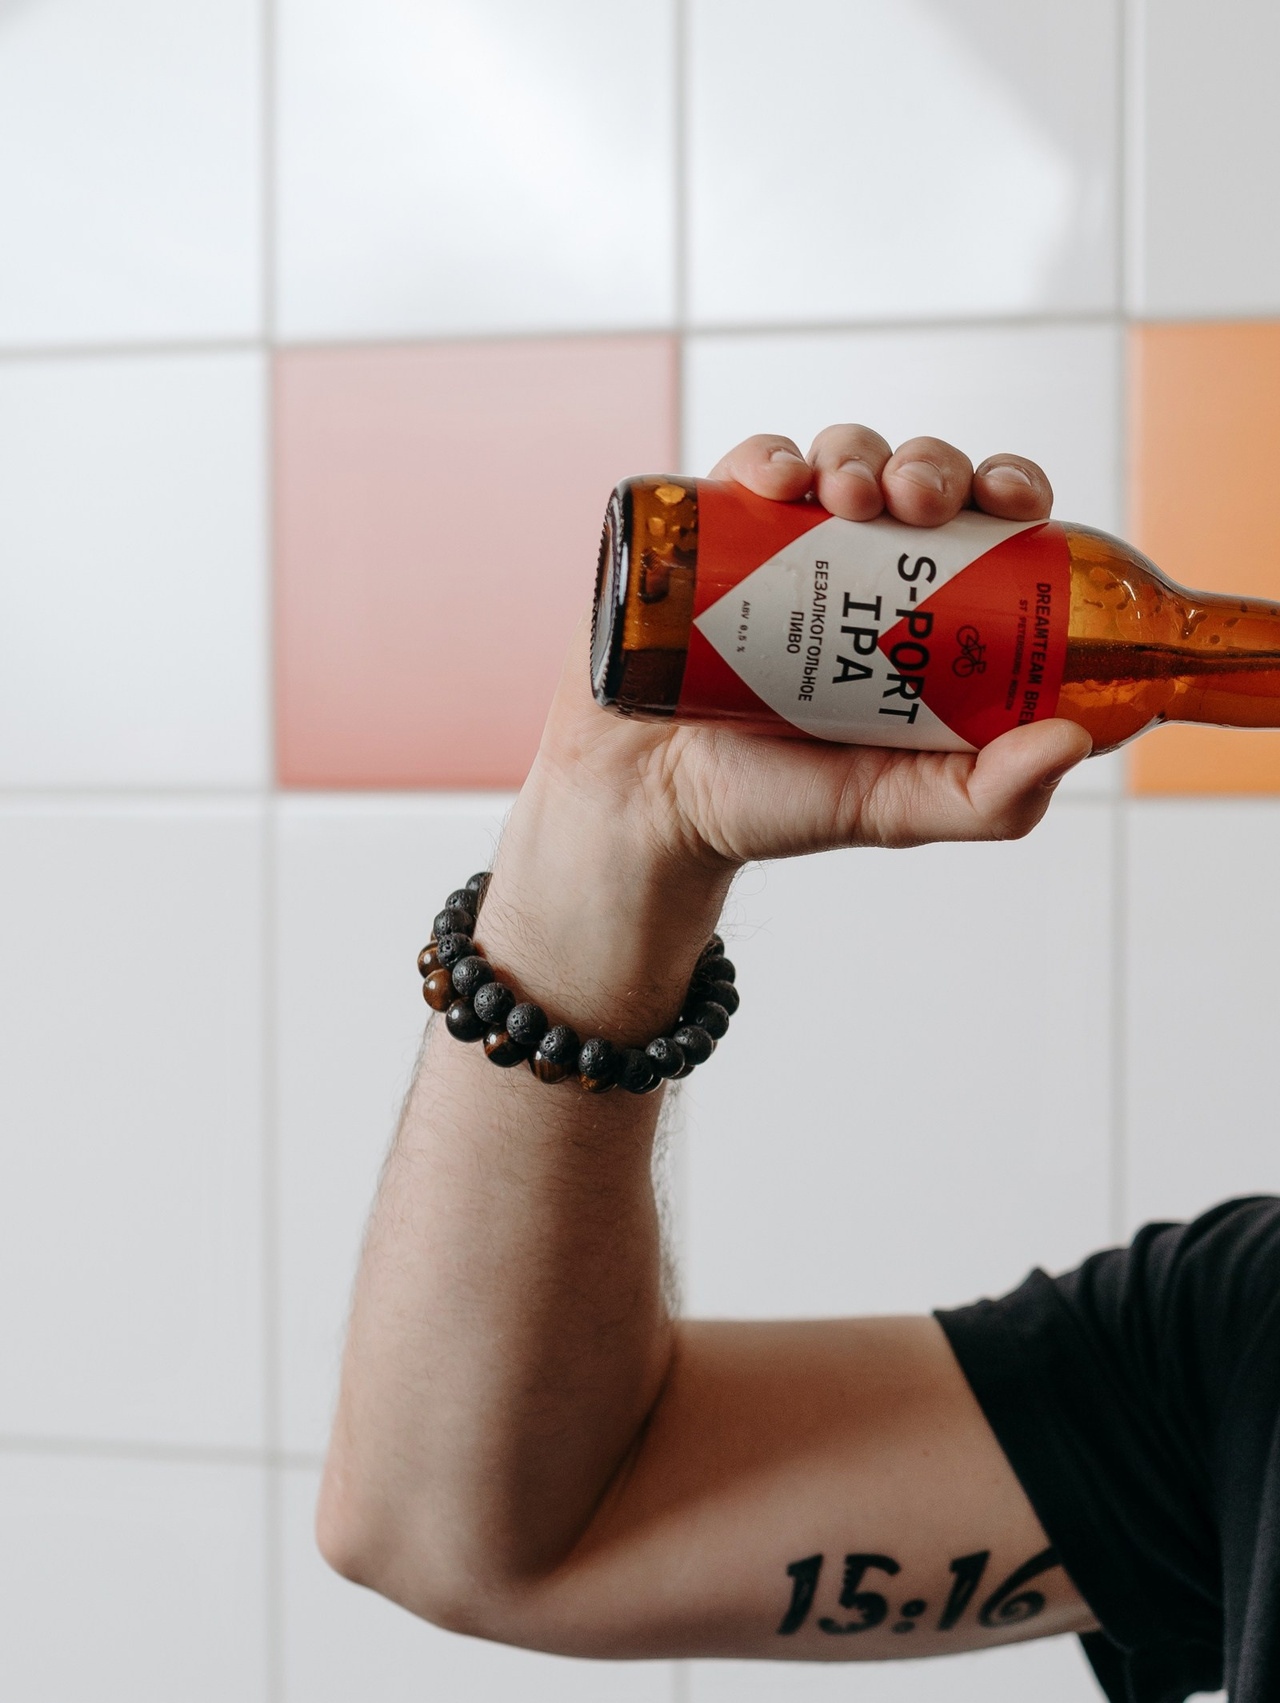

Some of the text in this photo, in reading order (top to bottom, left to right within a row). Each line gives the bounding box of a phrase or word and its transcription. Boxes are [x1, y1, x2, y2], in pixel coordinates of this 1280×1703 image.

[741, 600, 750, 620] ABV
[786, 611, 804, 654] ПИВО
[798, 560, 829, 701] БЕЗАЛКОГОЛЬНОЕ
[832, 592, 882, 684] IPA
[878, 553, 937, 725] S-PORT
[1027, 582, 1051, 686] DREAMTEAM
[776, 1550, 1062, 1635] 15:16
